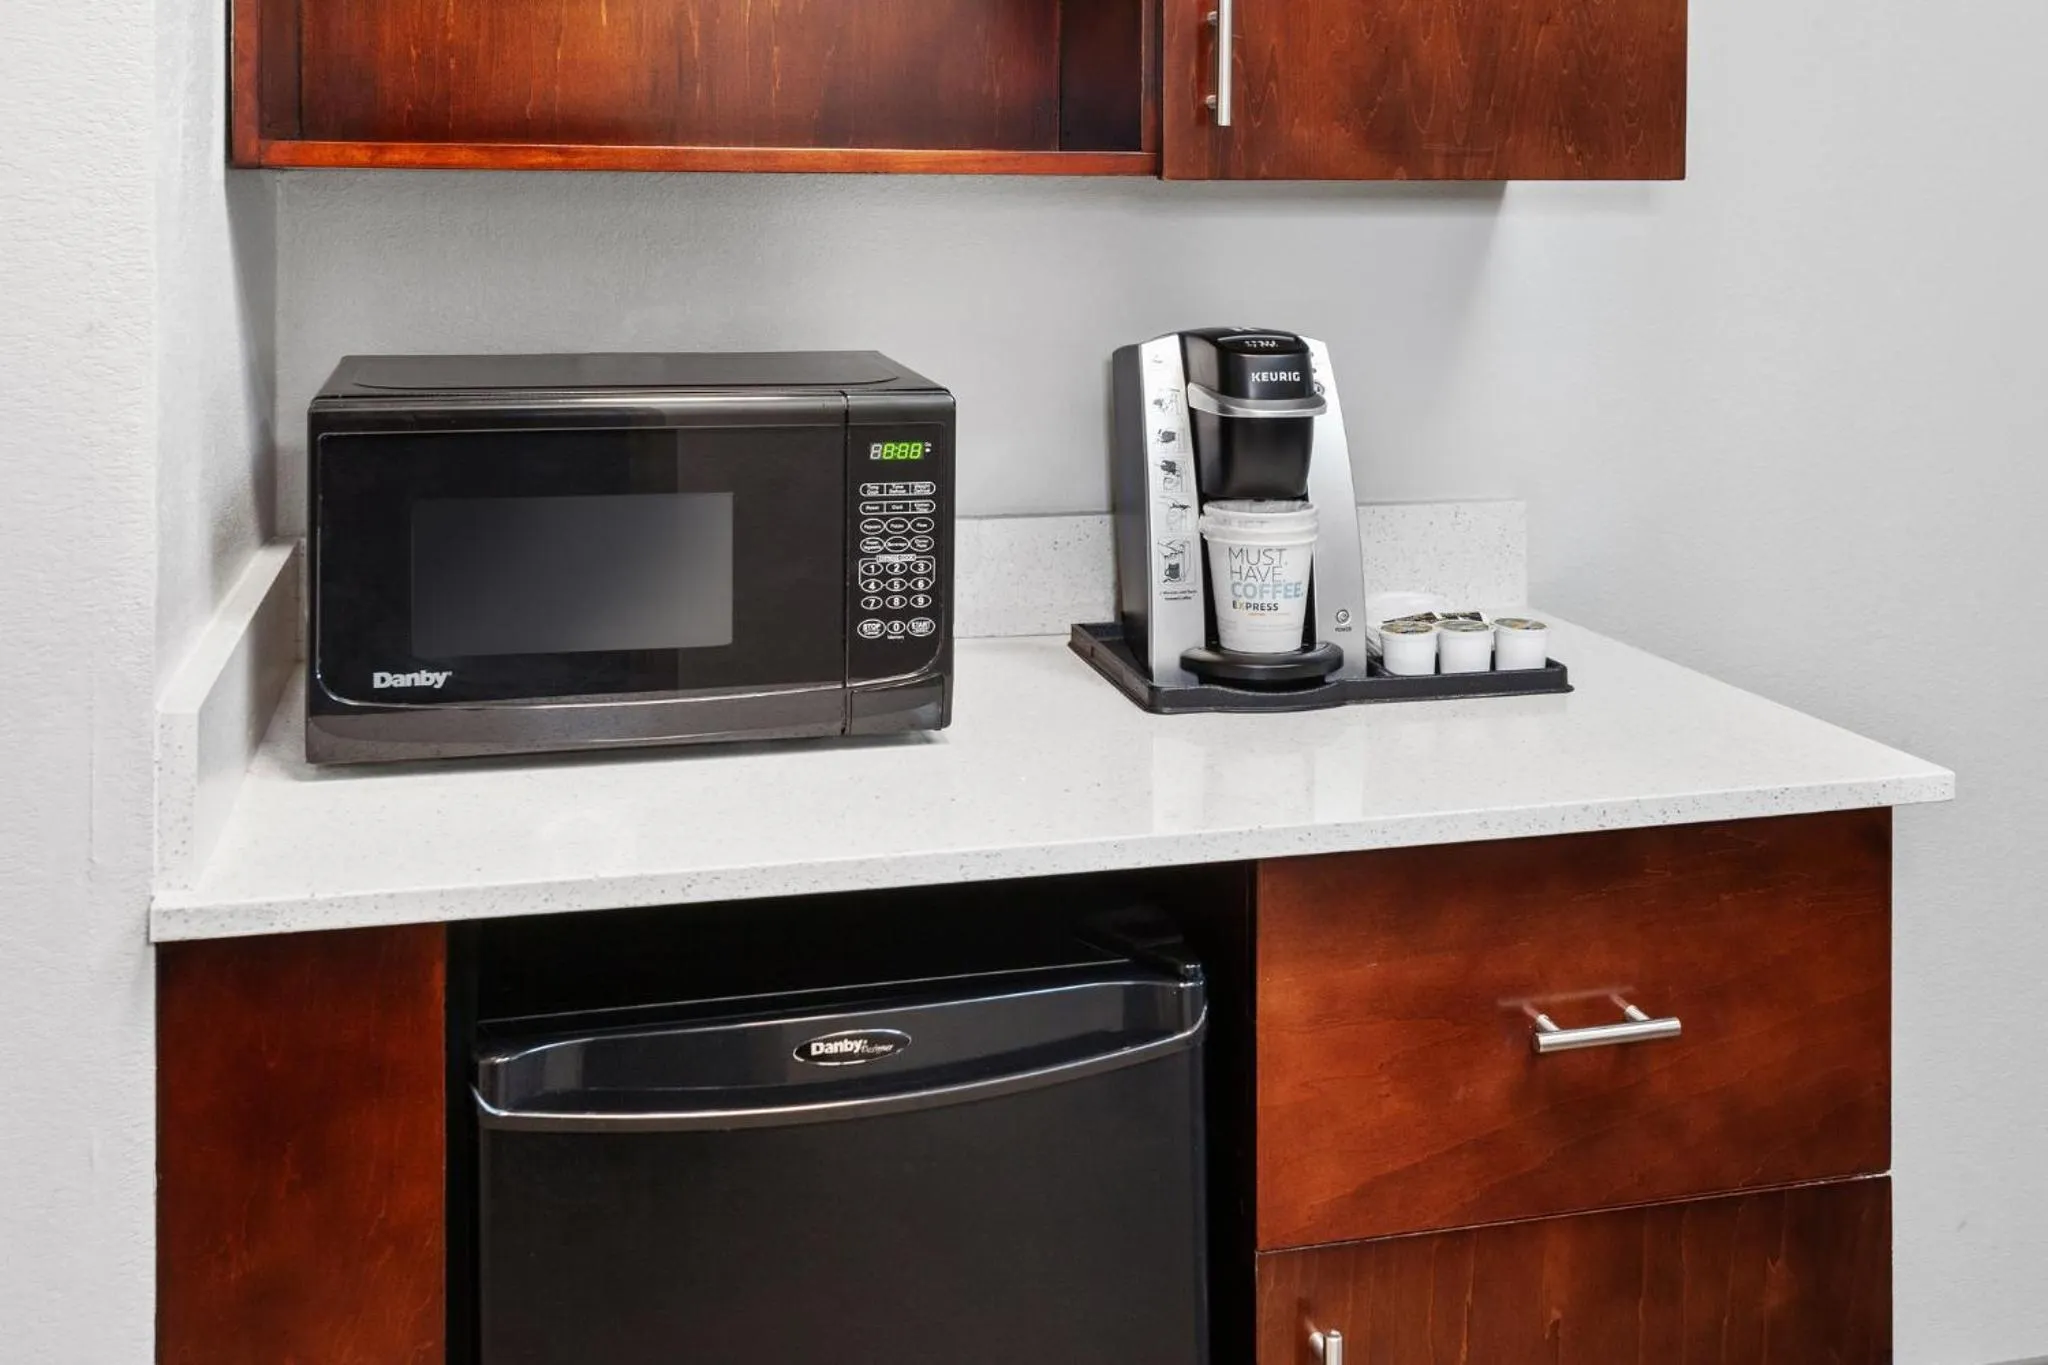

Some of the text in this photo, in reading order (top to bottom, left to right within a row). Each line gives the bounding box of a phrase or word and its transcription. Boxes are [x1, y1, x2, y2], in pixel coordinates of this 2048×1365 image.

[1251, 371, 1301, 382] KEURIG
[373, 670, 450, 689] Danby
[810, 1038, 866, 1056] Danby
